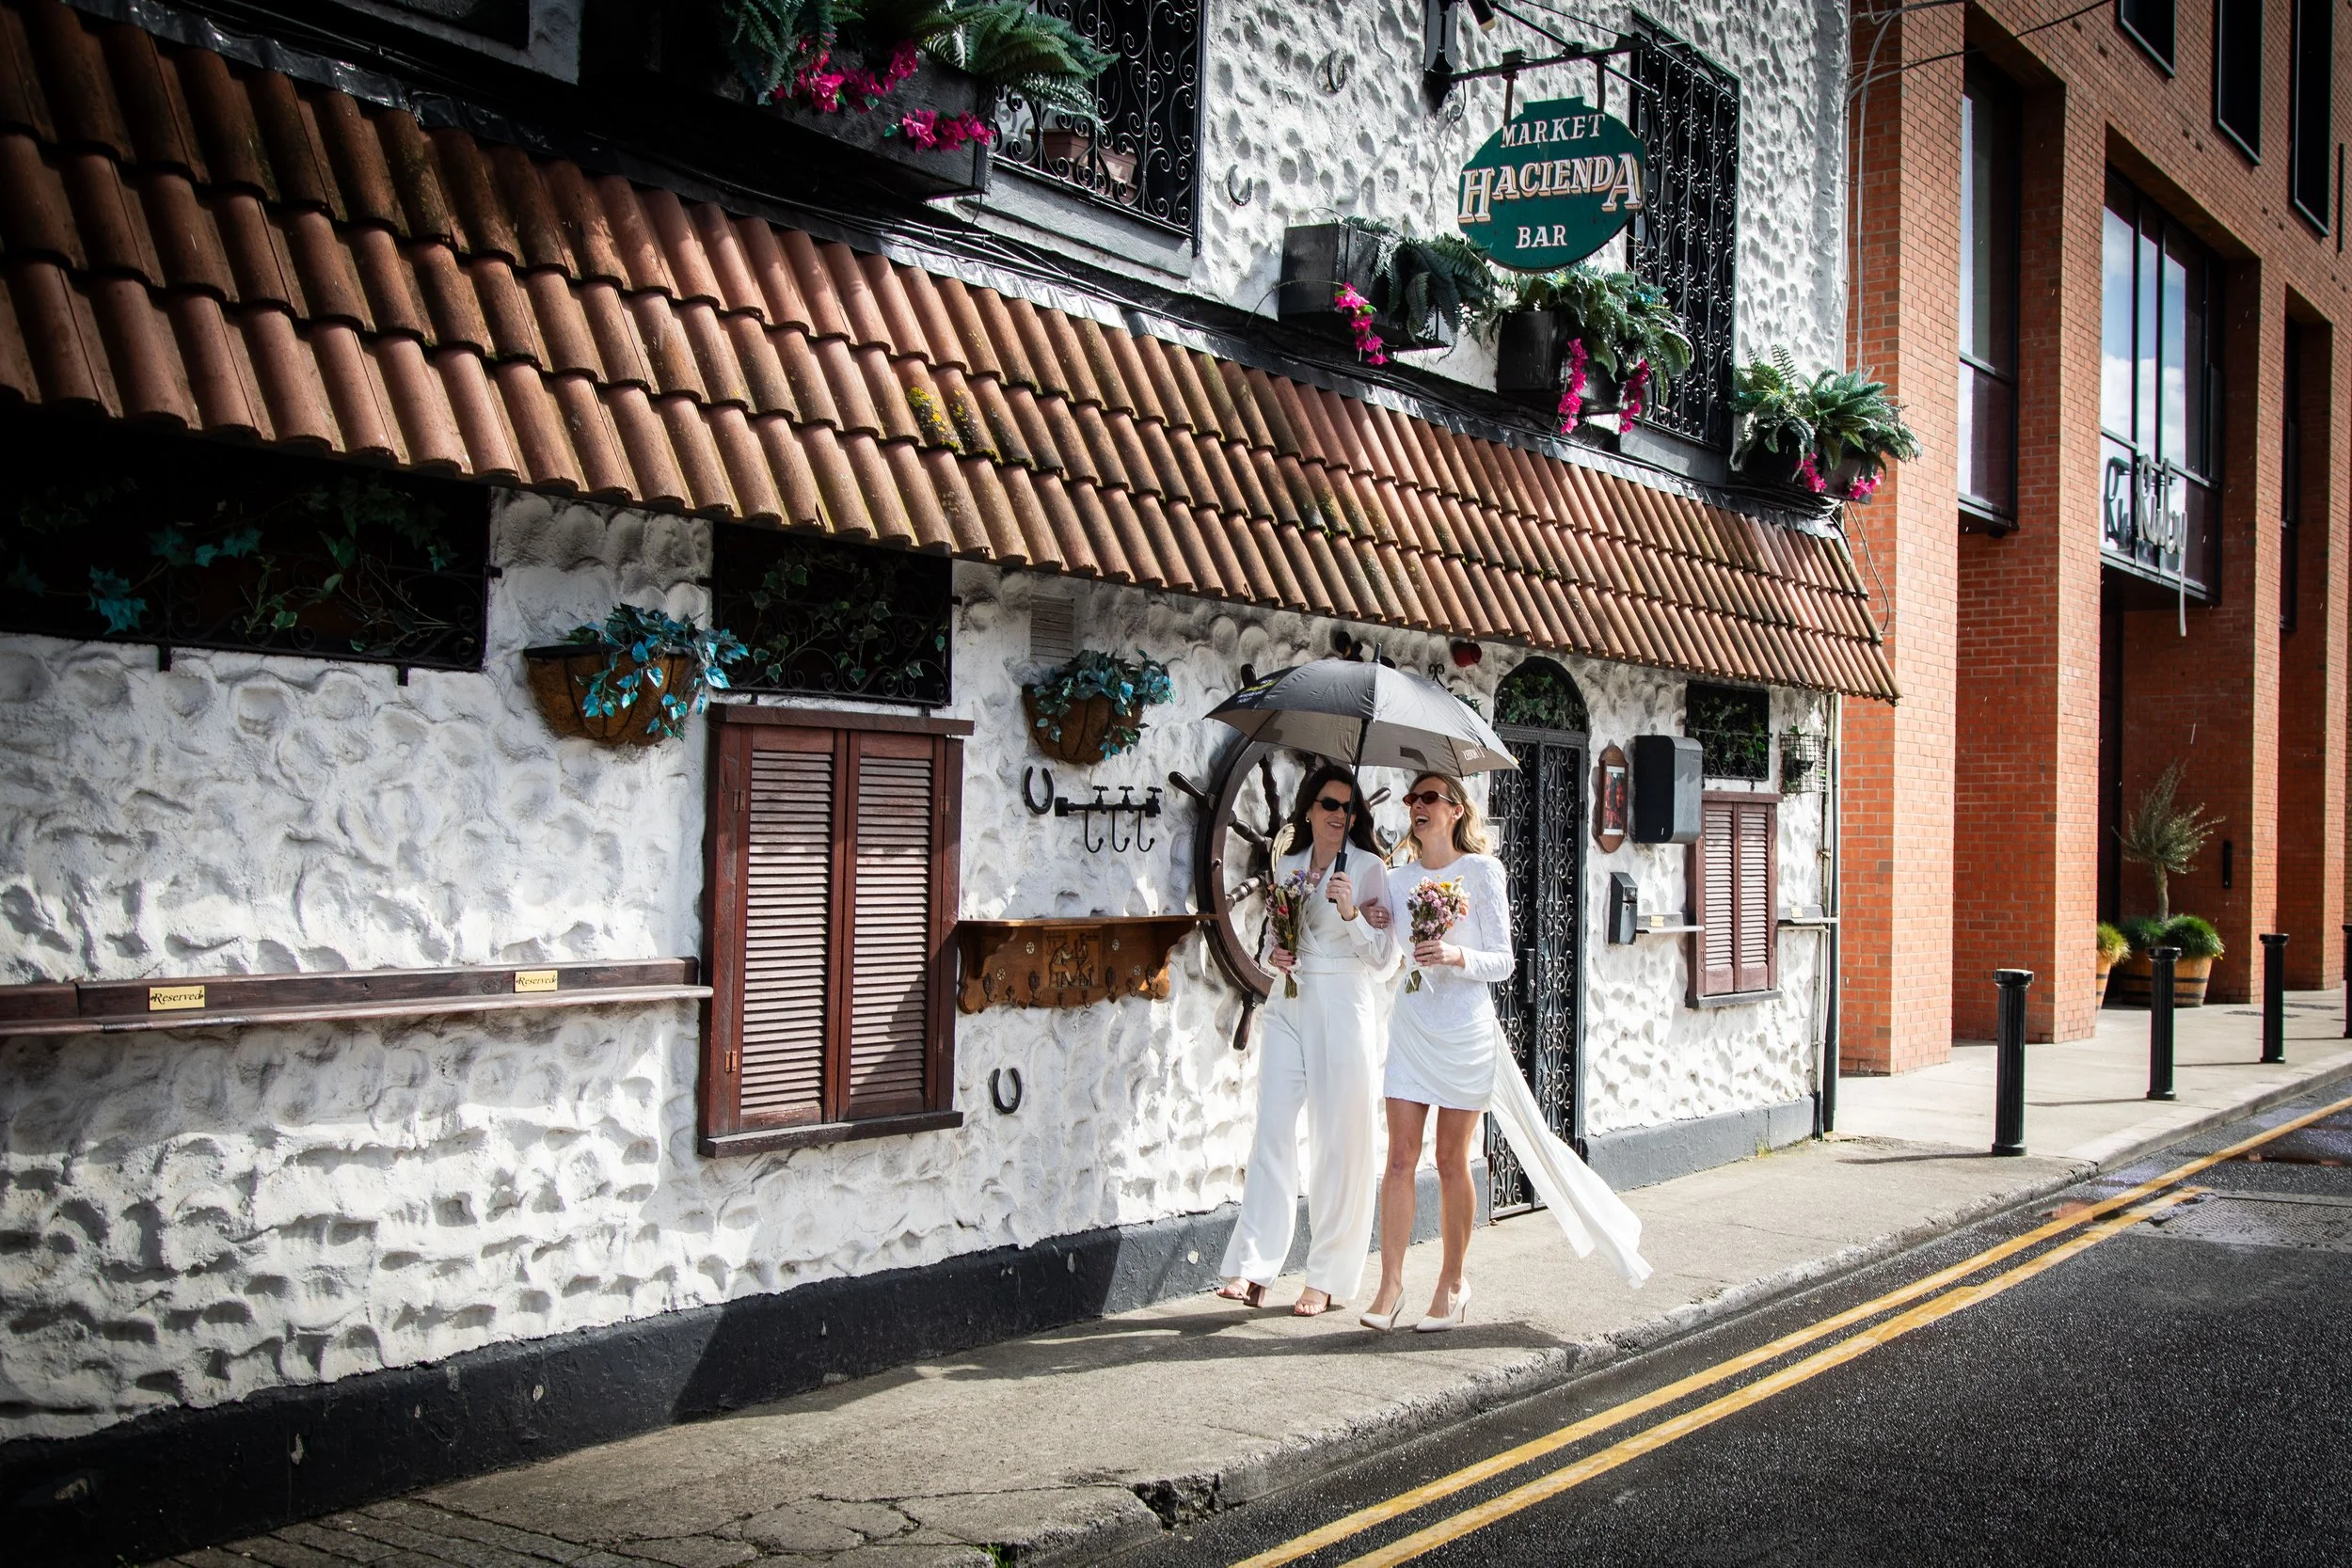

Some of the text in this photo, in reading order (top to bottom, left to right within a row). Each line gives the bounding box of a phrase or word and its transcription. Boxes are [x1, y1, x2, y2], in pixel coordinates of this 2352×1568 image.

[1501, 114, 1605, 148] MARKET
[1458, 152, 1645, 223] HACIENDA
[1516, 225, 1568, 248] BAR
[515, 974, 557, 987] Reserved
[151, 990, 204, 1005] Reserved
